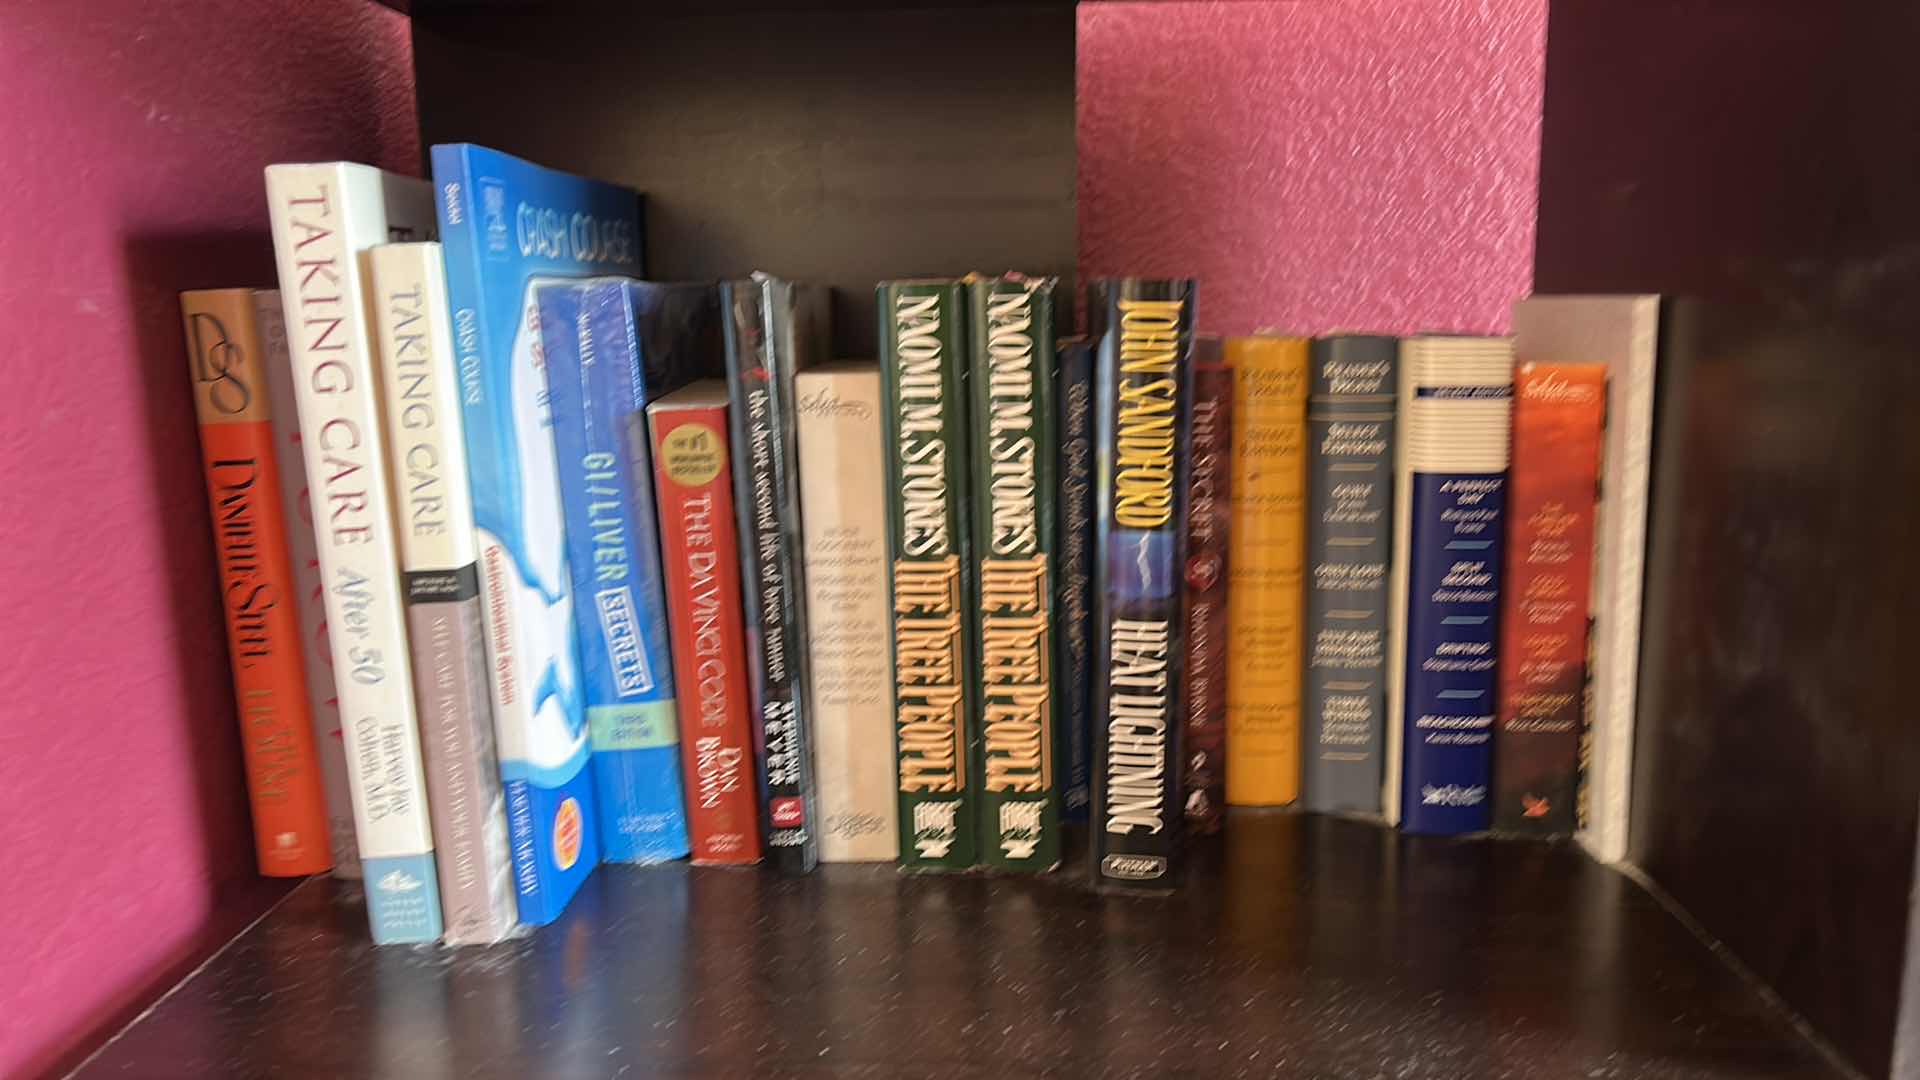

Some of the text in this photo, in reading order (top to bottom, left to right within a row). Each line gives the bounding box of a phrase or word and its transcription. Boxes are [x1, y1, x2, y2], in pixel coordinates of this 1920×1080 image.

[388, 285, 434, 431] TAKING
[896, 293, 943, 400] NAOMI
[986, 290, 1034, 398] NAOMI
[288, 184, 385, 686] TAKING CARE After 50
[747, 389, 769, 419] the
[900, 402, 944, 440] M.
[990, 401, 1034, 437] M.
[1115, 298, 1184, 529] JOHN SANDFORD
[750, 422, 773, 470] short
[1190, 397, 1217, 545] THE SECRET
[211, 457, 257, 580] DANIELLE
[405, 446, 446, 537] CARE
[582, 452, 630, 581] GI/LIVER
[682, 494, 713, 545] THE
[755, 471, 780, 529] second
[900, 439, 948, 556] STOKES
[990, 437, 1037, 556] STOKES
[688, 551, 719, 589] DA
[758, 532, 784, 562] life
[762, 566, 785, 586] of
[894, 554, 961, 612] THE
[981, 553, 1048, 611] THE
[226, 580, 277, 658] STEEL
[603, 593, 645, 692] SECRETS
[691, 589, 723, 655] VINCI
[896, 612, 962, 685] TREE
[982, 611, 1049, 684] TREE
[495, 655, 517, 706] System
[696, 658, 728, 728] CODE
[762, 701, 785, 786] MEYER
[899, 685, 965, 792] PEOPLE
[984, 684, 1051, 792] PEOPLE
[1106, 618, 1168, 835] HEAT LIGHTNING
[695, 736, 722, 808] BROWN
[716, 746, 743, 794] DAN
